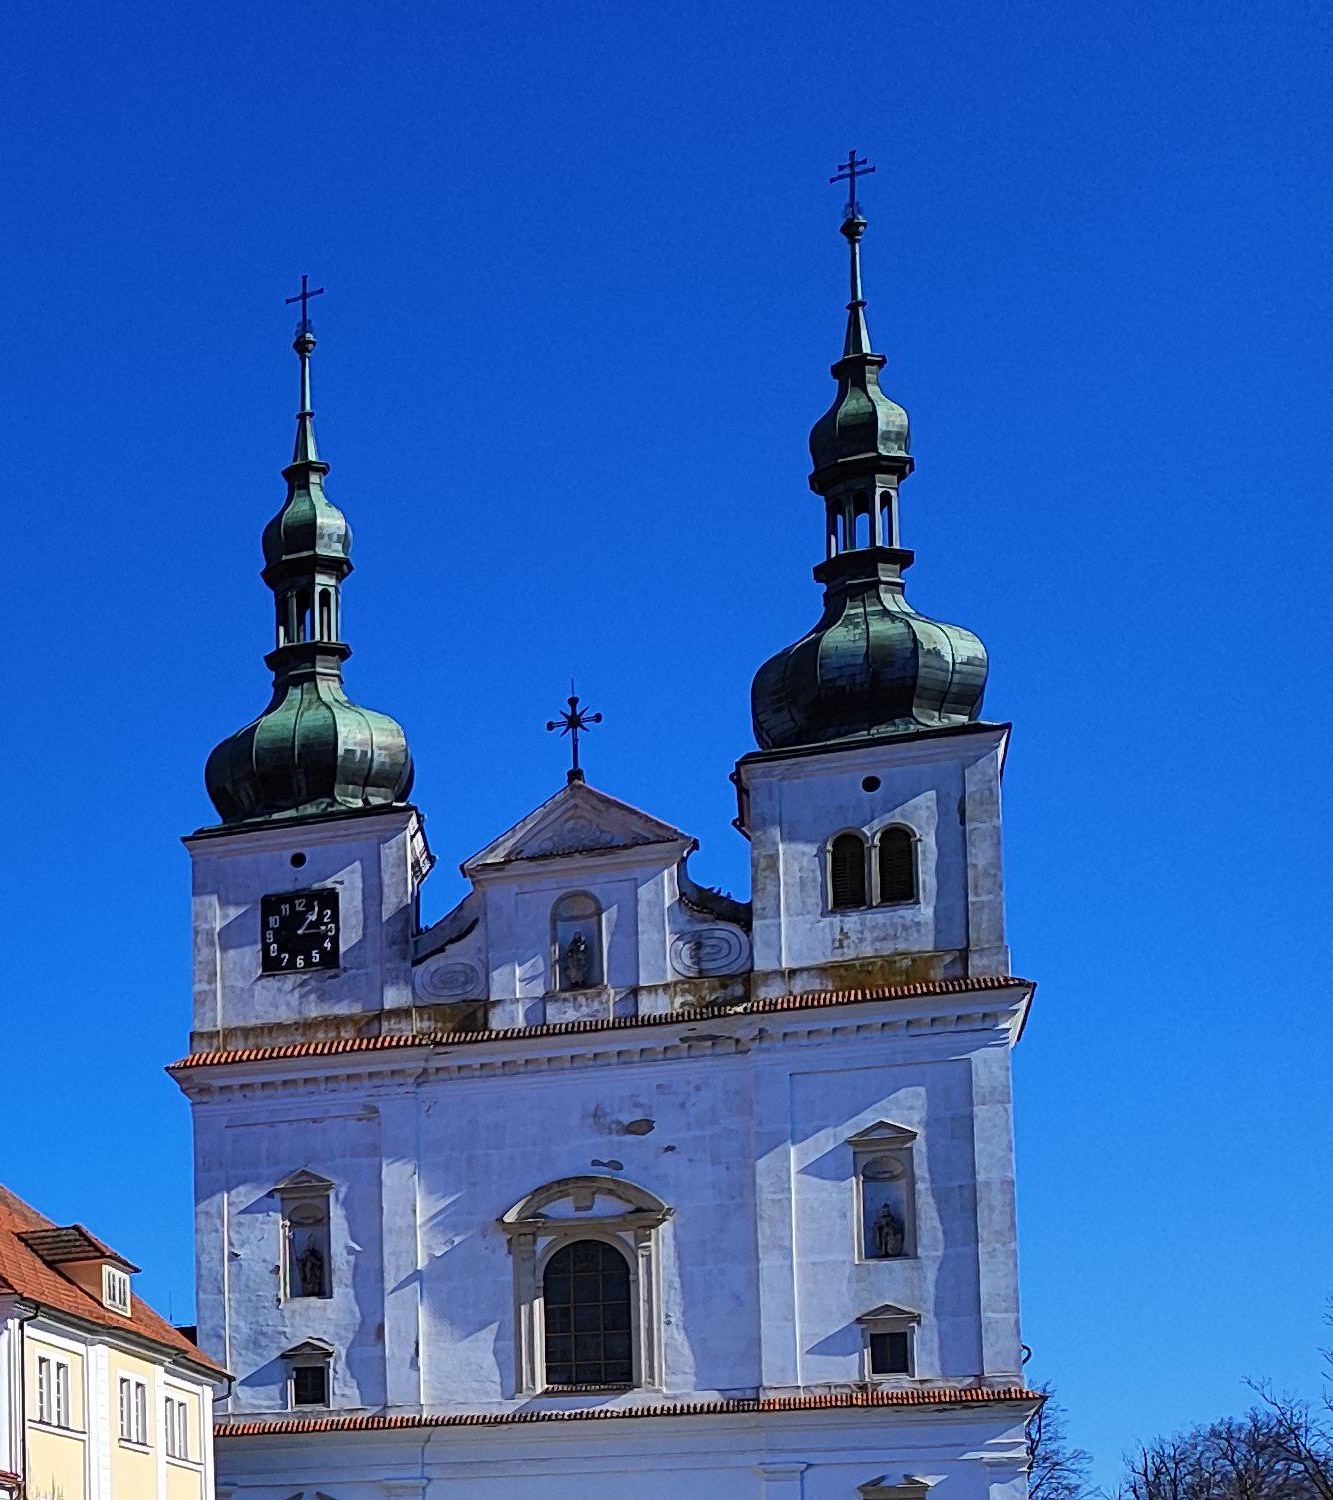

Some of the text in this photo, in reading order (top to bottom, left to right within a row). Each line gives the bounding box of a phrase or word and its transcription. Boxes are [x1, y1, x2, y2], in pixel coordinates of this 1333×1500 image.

[281, 904, 289, 916] 11
[295, 899, 306, 911] 12
[323, 909, 331, 922] 2
[269, 916, 279, 928] 10
[323, 938, 331, 950] 4
[281, 953, 288, 966] 7
[296, 955, 304, 967] 6
[312, 950, 319, 962] 5
